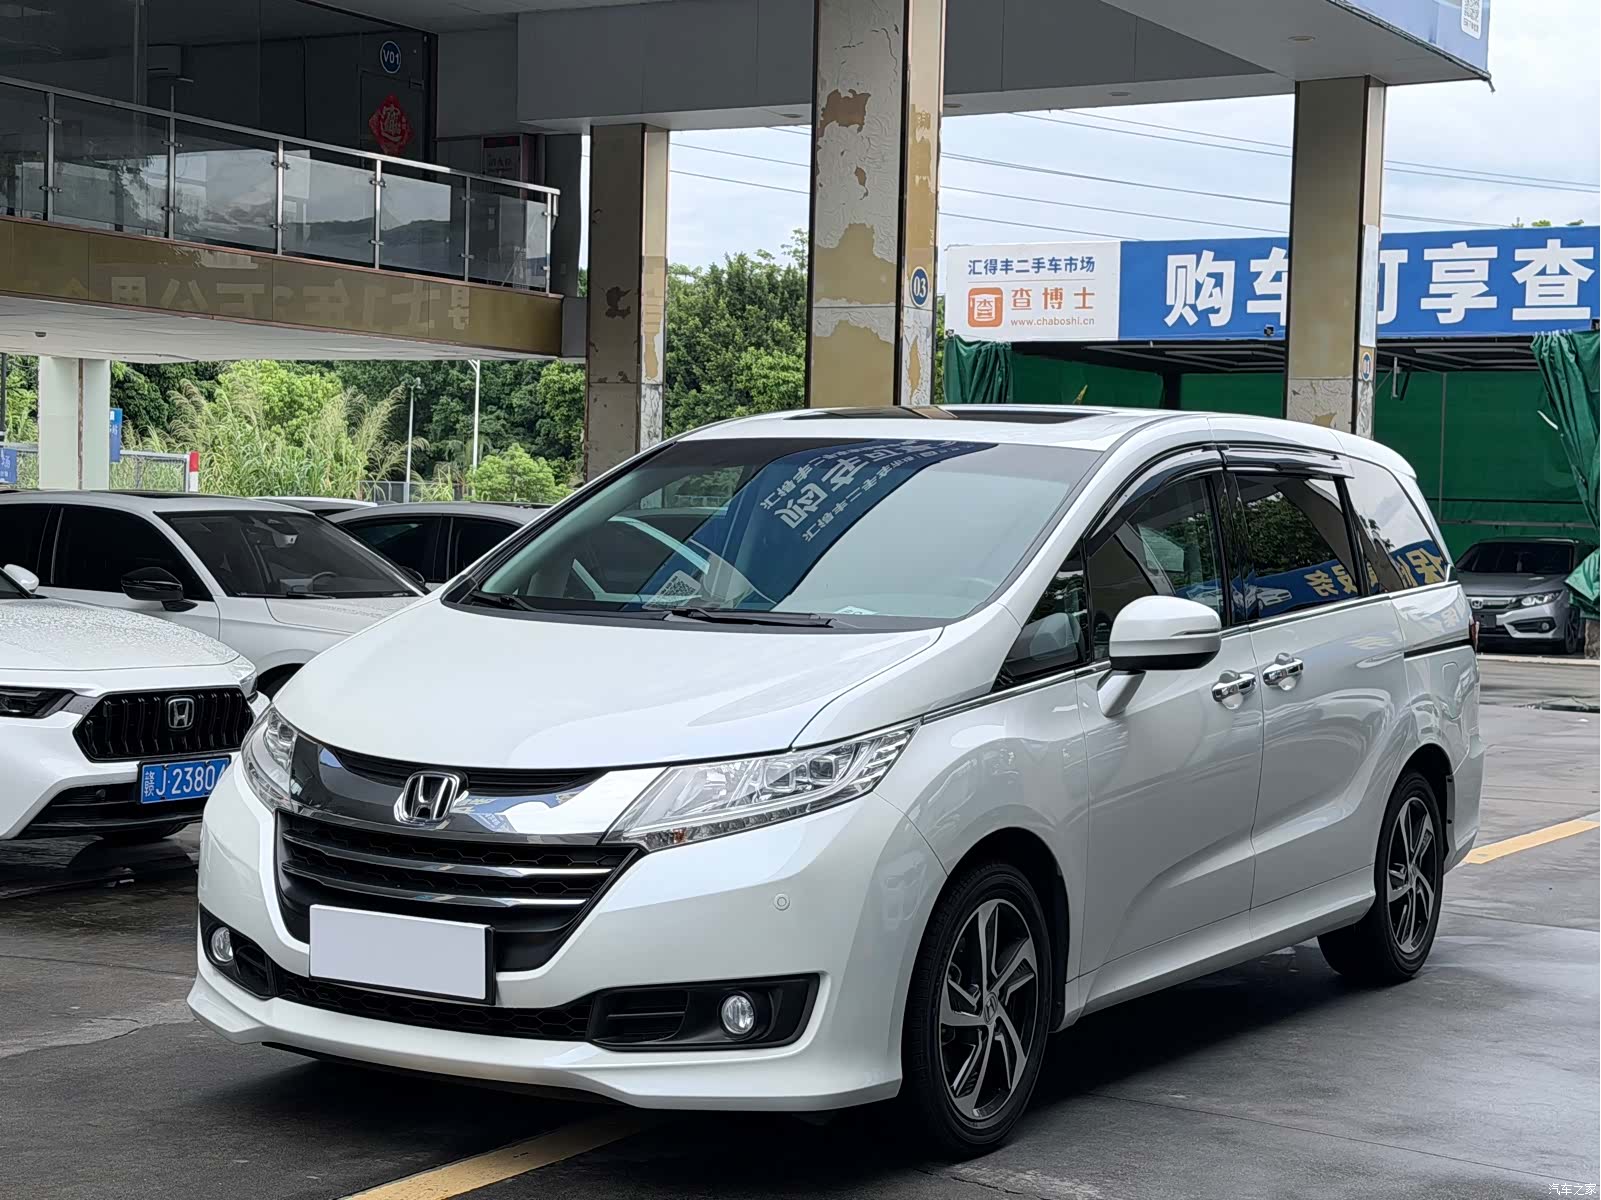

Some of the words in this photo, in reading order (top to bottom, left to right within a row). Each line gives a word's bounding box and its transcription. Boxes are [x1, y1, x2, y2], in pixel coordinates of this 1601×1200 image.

[383, 49, 400, 65] V01
[967, 256, 1096, 276] 汇得丰二手车市场
[913, 275, 927, 298] 03
[1011, 286, 1096, 311] 查博士
[1010, 316, 1096, 327] www.chaboshi.cn
